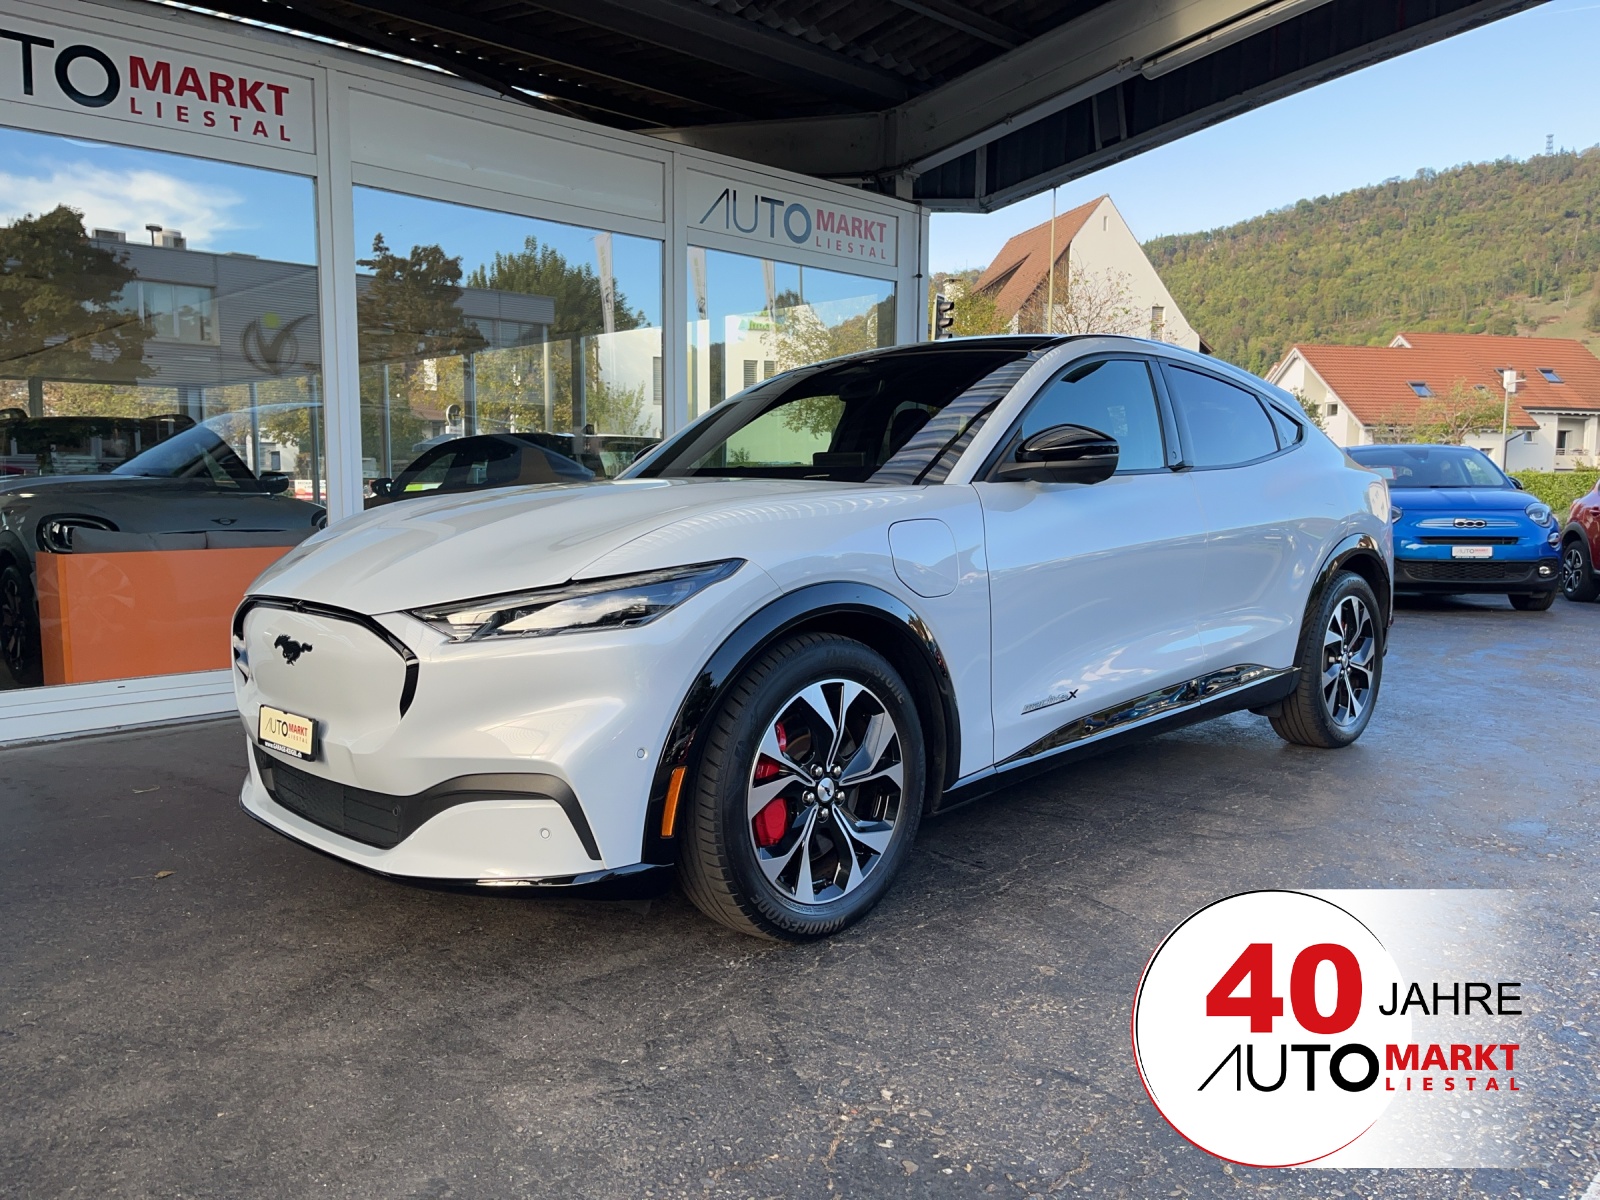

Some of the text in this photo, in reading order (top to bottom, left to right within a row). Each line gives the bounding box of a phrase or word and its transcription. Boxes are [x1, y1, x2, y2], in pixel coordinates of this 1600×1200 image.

[129, 55, 289, 116] MARKT
[130, 97, 291, 142] LIESTAL
[700, 188, 887, 244] AUTO MARKT
[816, 235, 886, 260] LIESTAL
[1454, 518, 1486, 528] 500
[265, 717, 308, 737] AUTO MARKT
